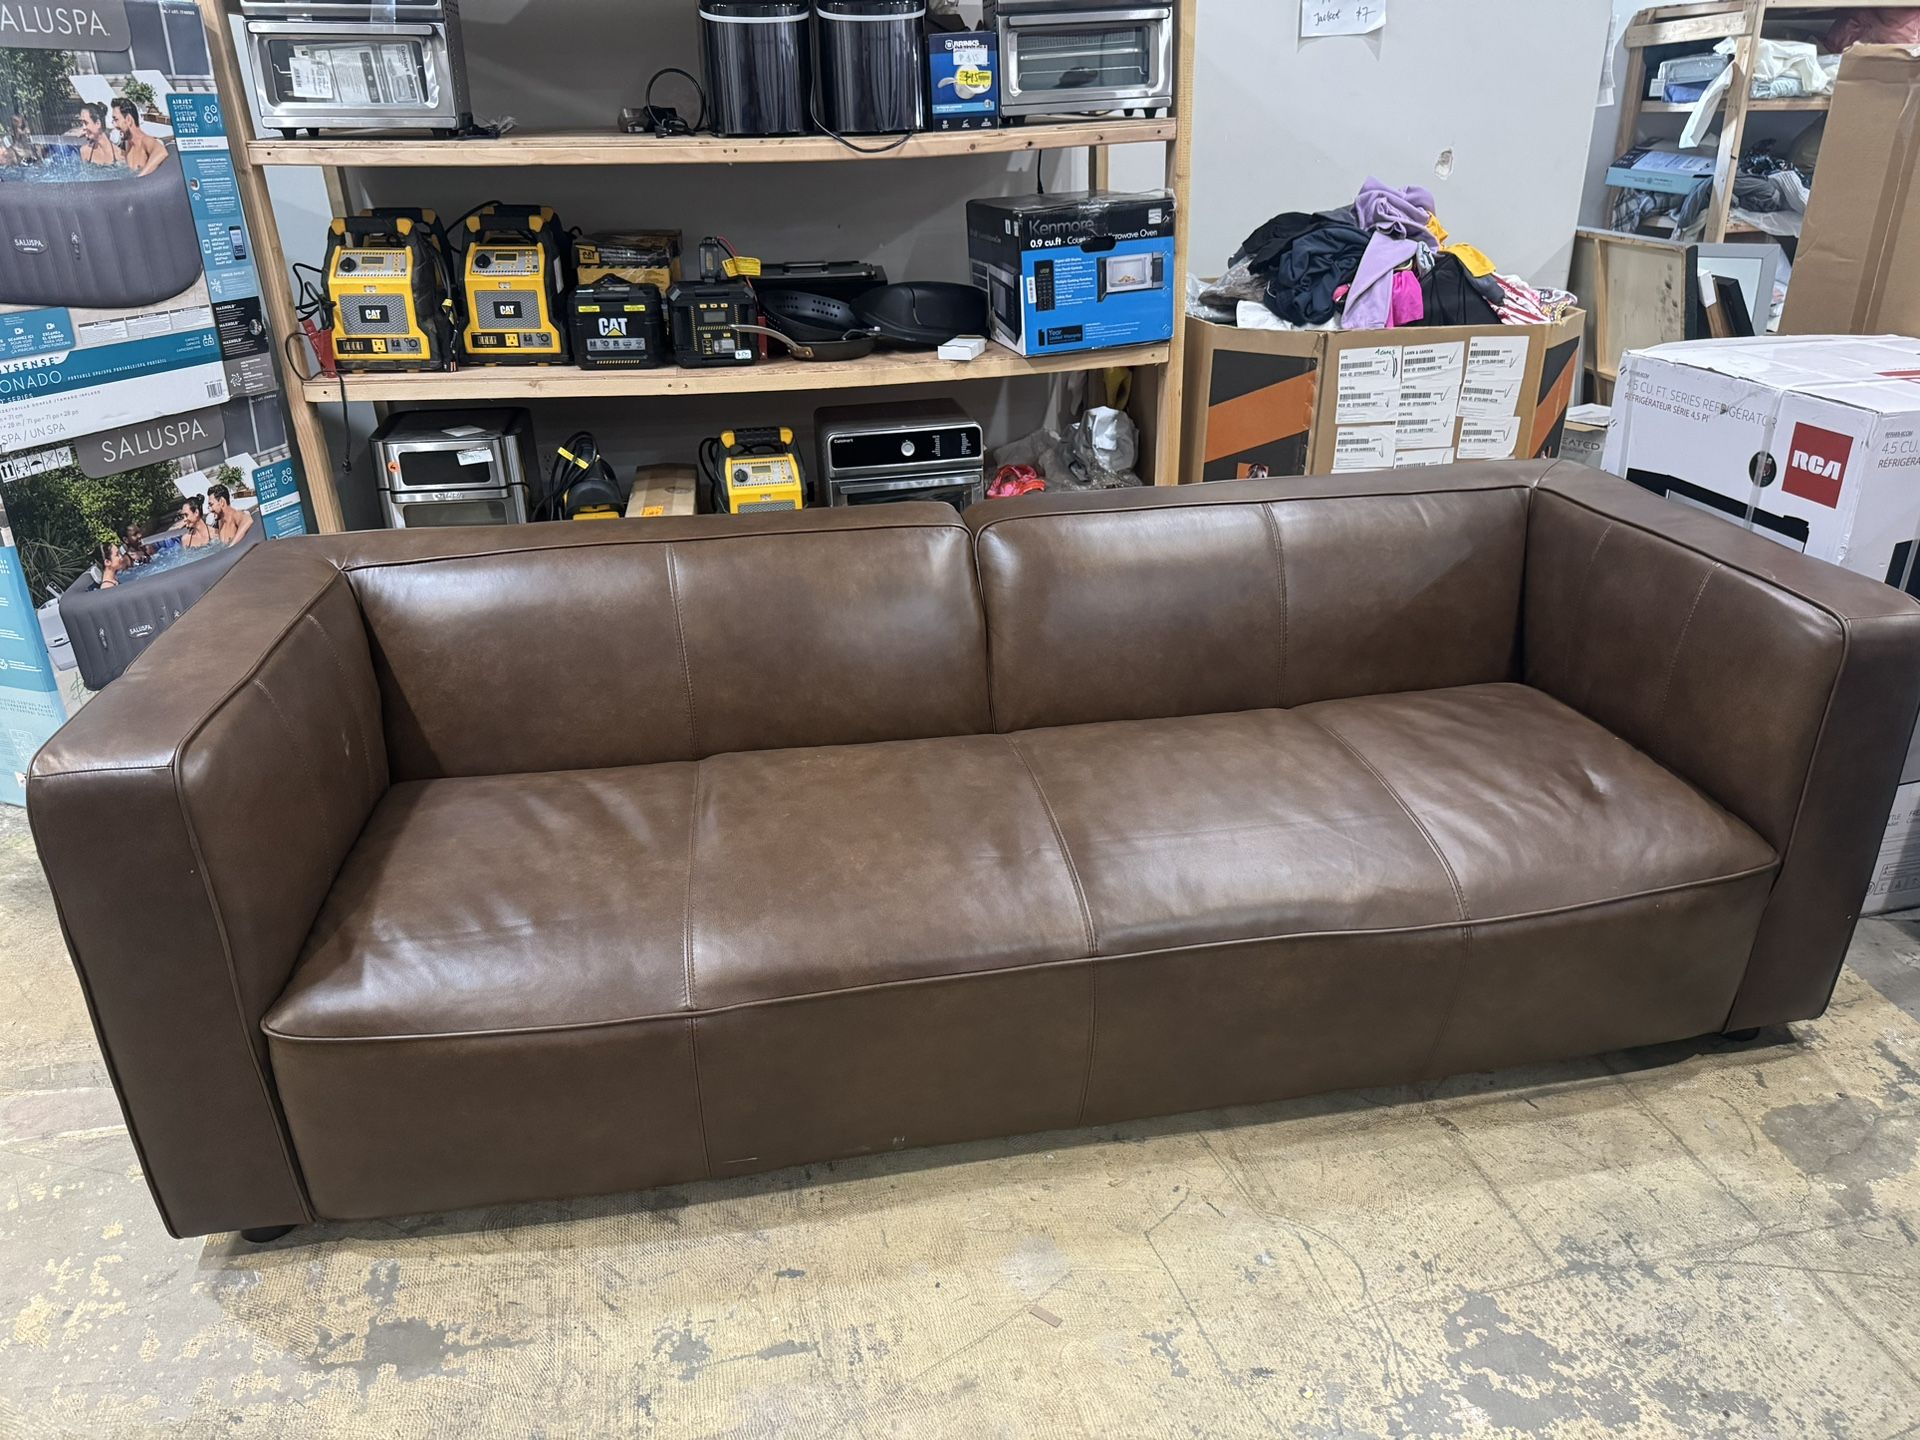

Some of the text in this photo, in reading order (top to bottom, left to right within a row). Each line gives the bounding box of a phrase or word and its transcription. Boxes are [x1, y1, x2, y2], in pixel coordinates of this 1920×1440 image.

[1029, 219, 1094, 236] Kenmore
[1030, 239, 1043, 248] 0.9
[1139, 228, 1158, 238] Oven
[365, 310, 381, 320] CAT
[500, 306, 515, 315] CAT
[598, 318, 628, 336] CAT
[0, 357, 55, 374] YSENSE
[1671, 390, 1701, 408] SERIES
[2, 432, 22, 446] SPA
[30, 427, 46, 439] UN
[47, 422, 66, 435] SPA
[101, 418, 206, 463] SALUSPA
[1882, 440, 1919, 455] 4.5 CU.
[1792, 450, 1842, 481] RCA
[129, 625, 153, 635] SALUSPA
